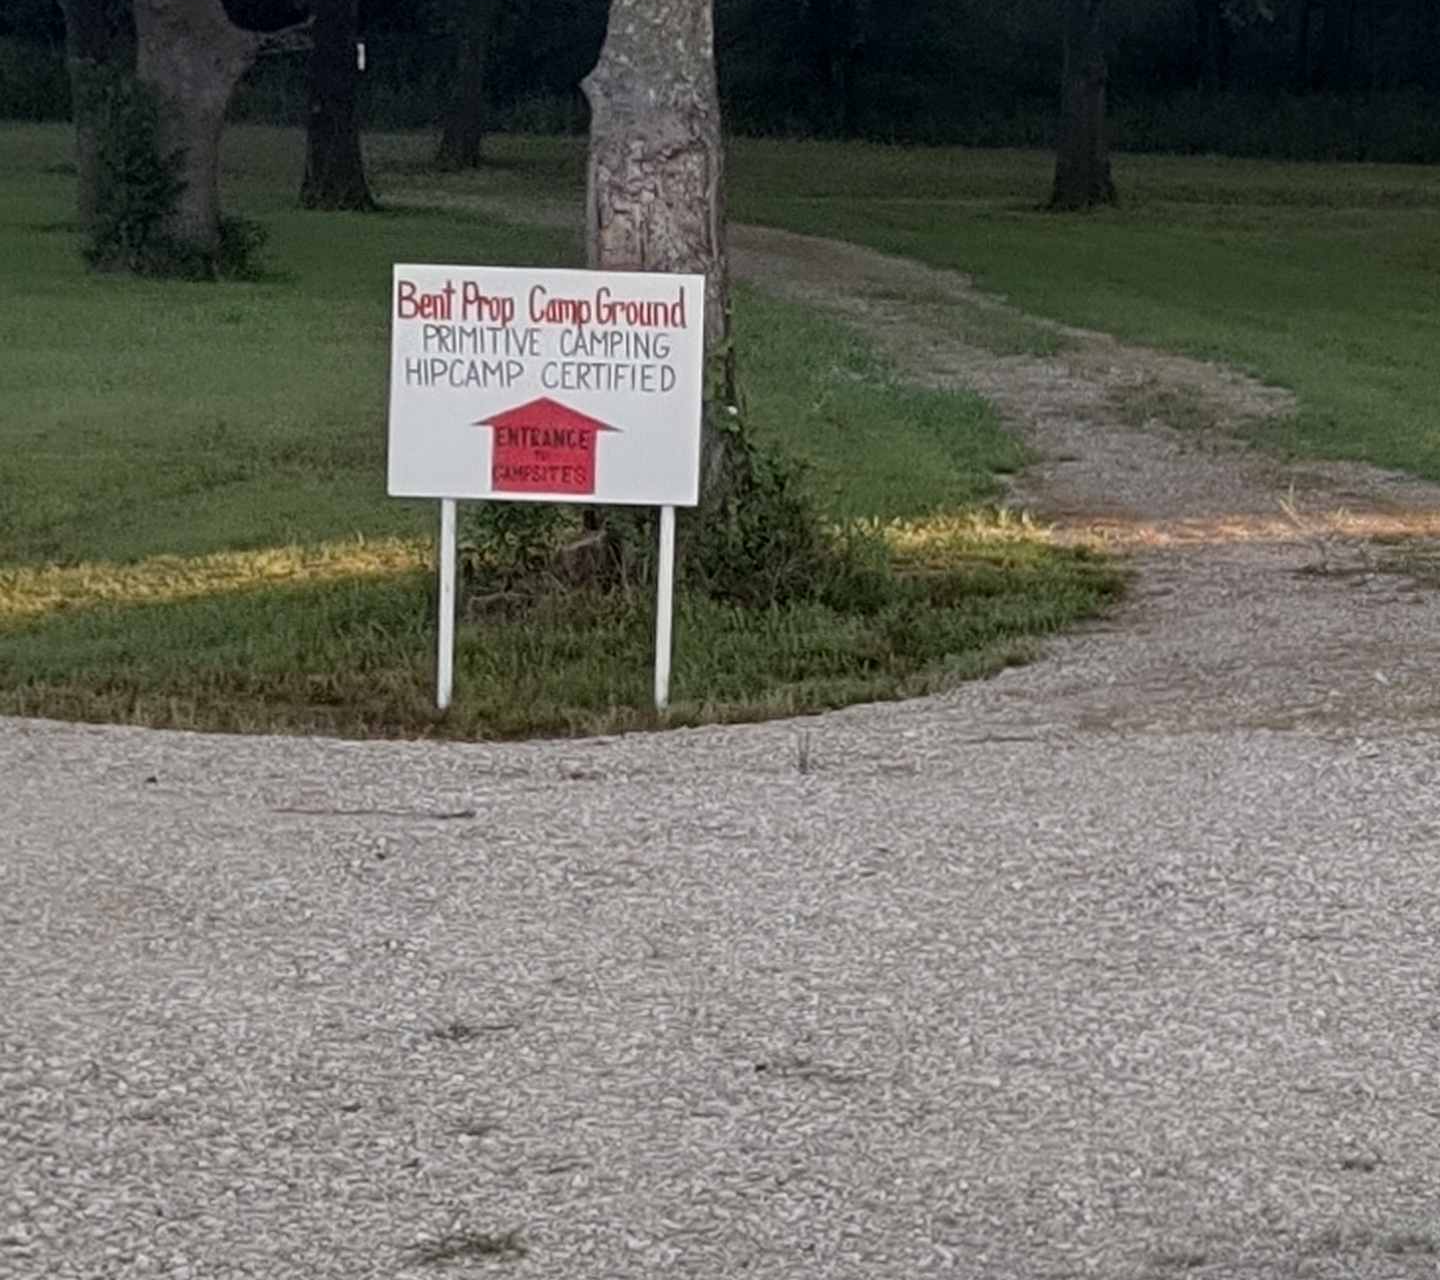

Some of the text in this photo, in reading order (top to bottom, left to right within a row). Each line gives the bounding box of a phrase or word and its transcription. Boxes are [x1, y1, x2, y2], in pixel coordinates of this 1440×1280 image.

[398, 281, 455, 319] Bent
[463, 282, 514, 327] Prop
[423, 325, 670, 358] PRIMITIVE CAMPING
[405, 358, 676, 392] HIPCAMP CERTIFIED
[496, 426, 590, 450] ENTRANCE
[494, 464, 588, 484] CAMPSITES
